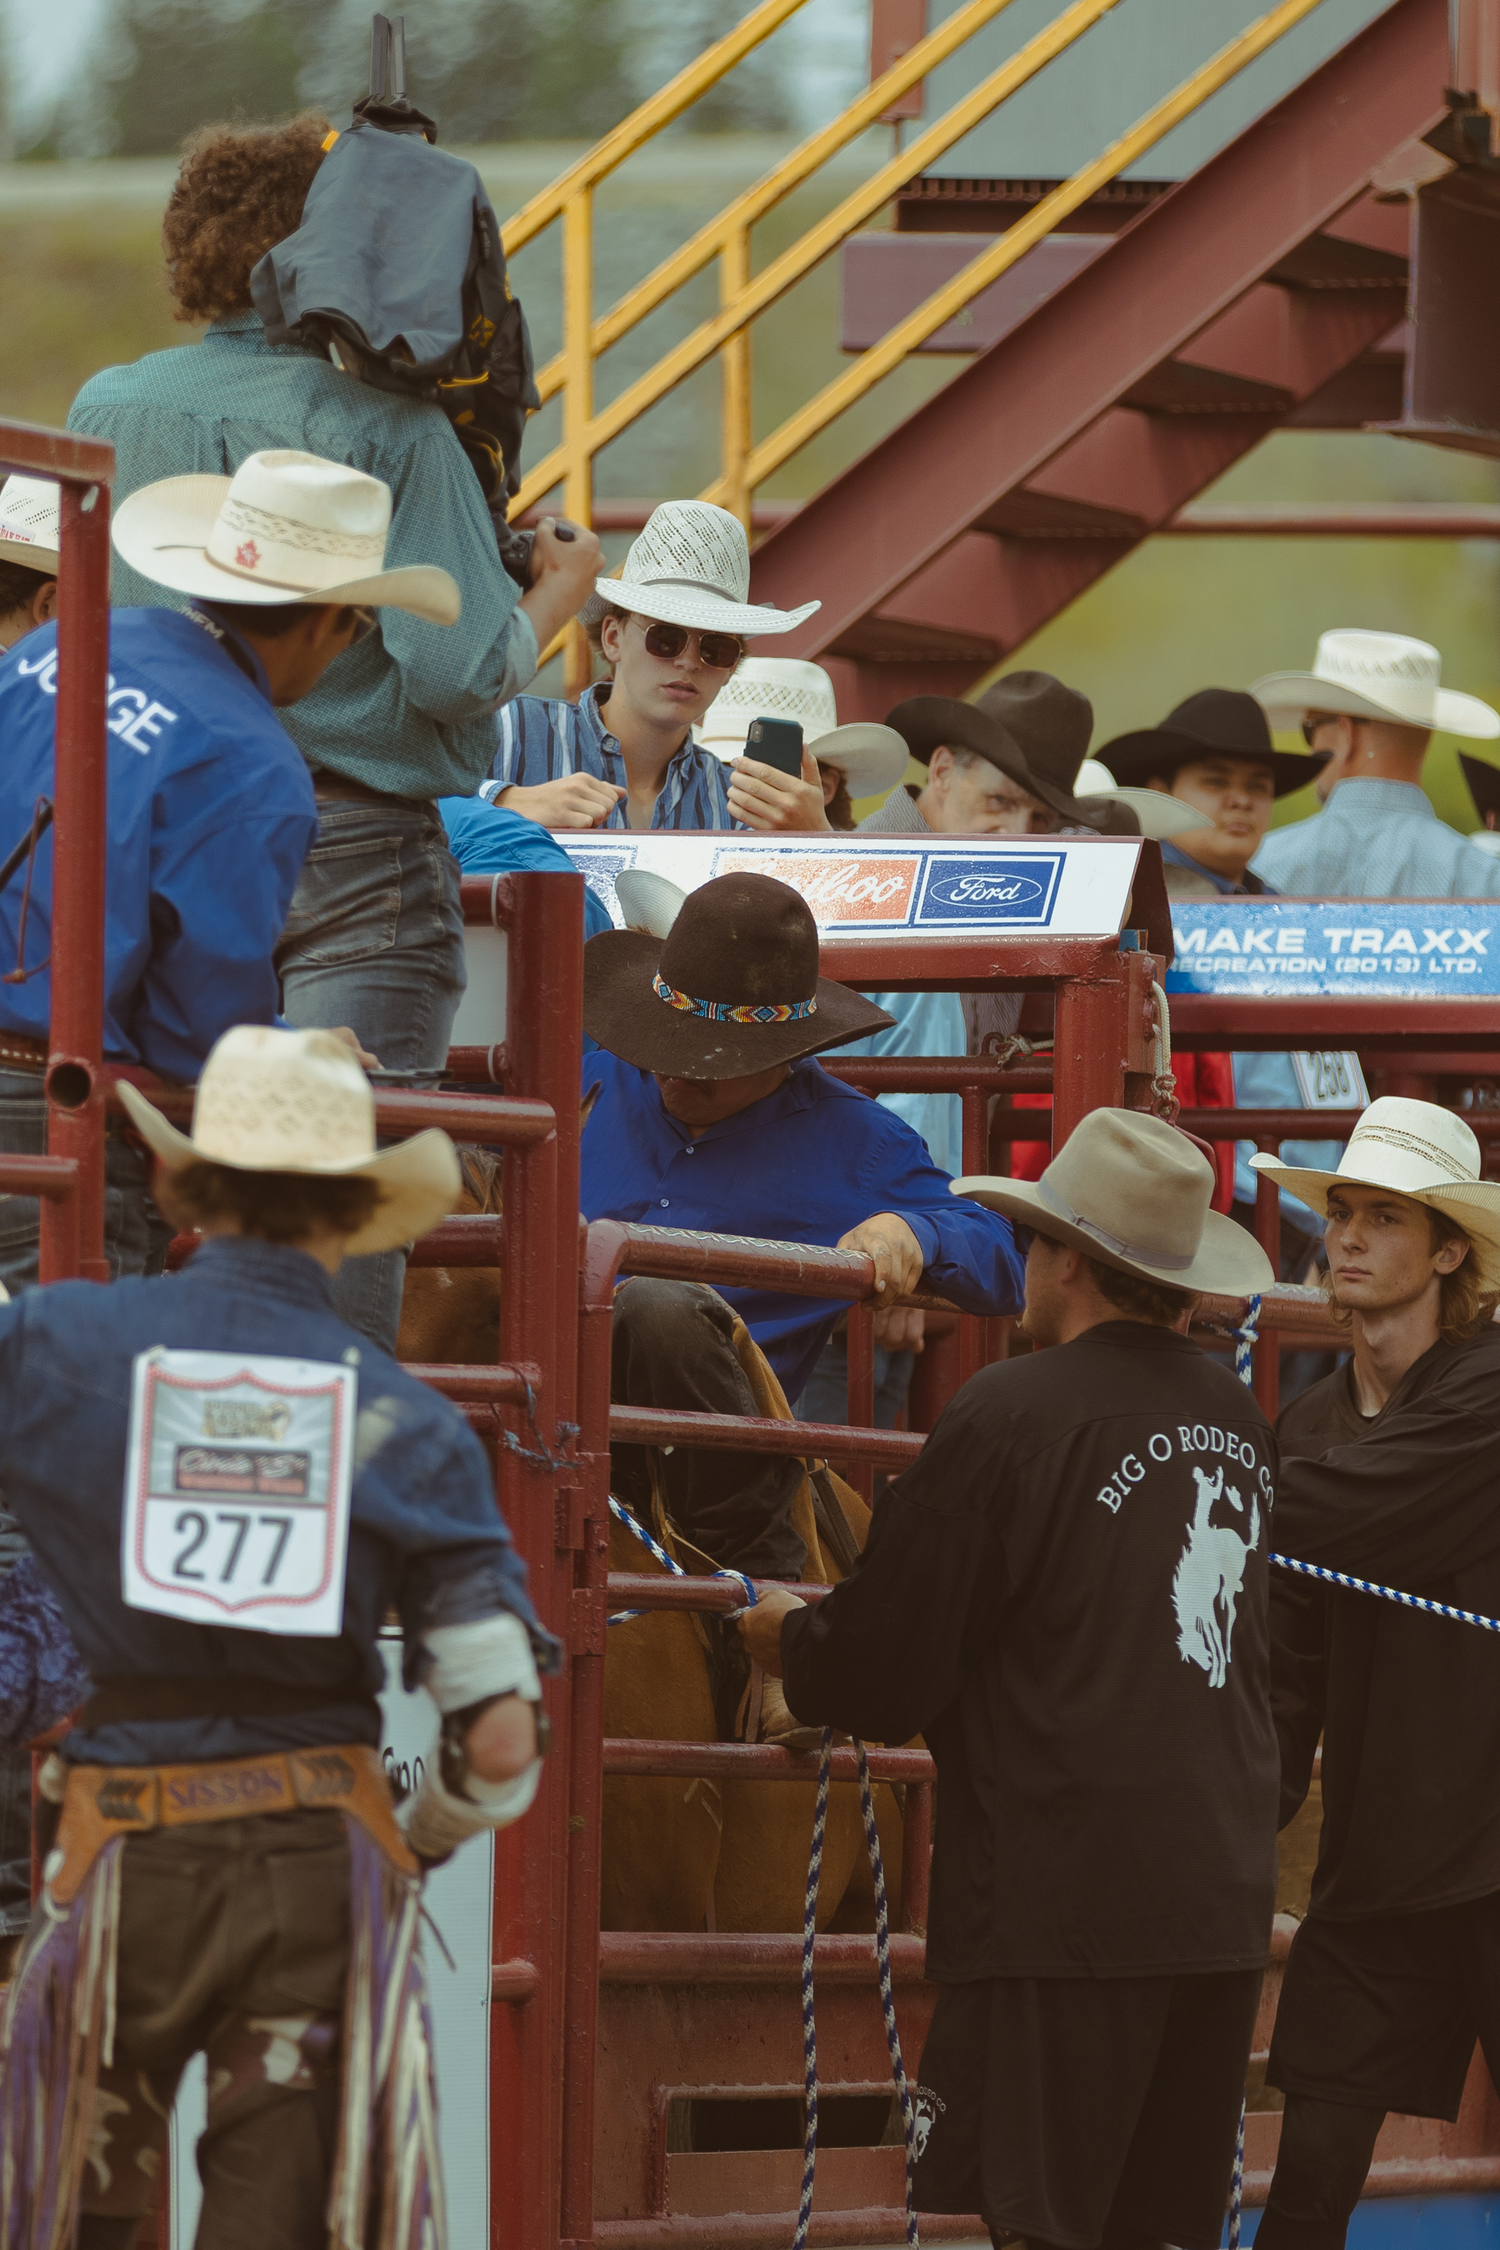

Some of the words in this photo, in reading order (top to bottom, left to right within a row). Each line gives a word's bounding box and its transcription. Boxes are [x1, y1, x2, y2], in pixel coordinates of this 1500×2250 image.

[950, 877, 1022, 901] Ford
[1173, 928, 1306, 954] MAKE
[1323, 928, 1491, 954] TRAXX
[1335, 957, 1420, 973] (2013)
[1429, 957, 1483, 974] LTD.
[1097, 1453, 1146, 1514] BIG
[1148, 1433, 1173, 1462] O
[1177, 1424, 1256, 1469] RODEO
[172, 1510, 294, 1586] 277
[167, 1765, 284, 1812] SISSON
